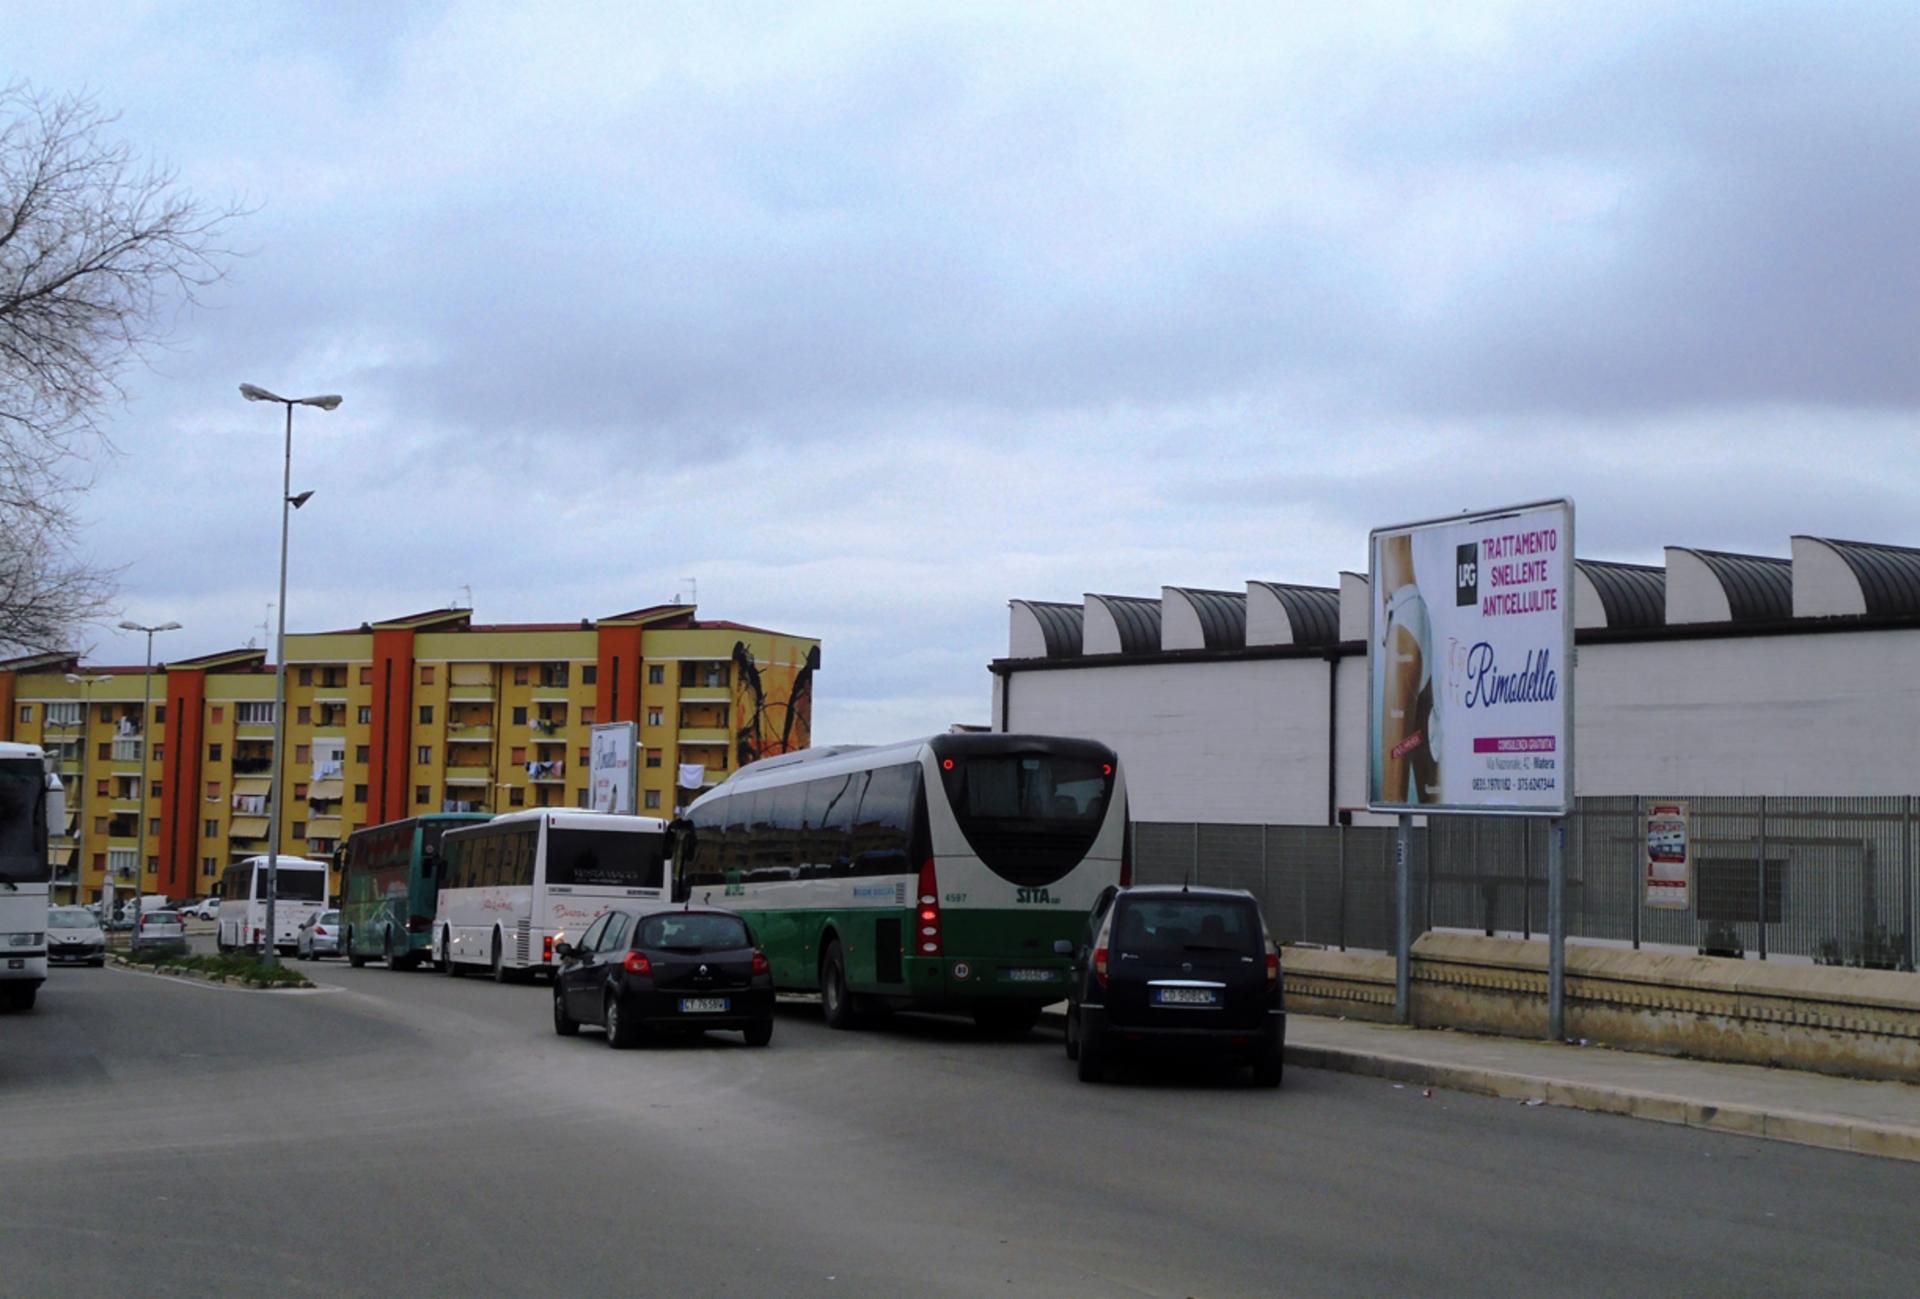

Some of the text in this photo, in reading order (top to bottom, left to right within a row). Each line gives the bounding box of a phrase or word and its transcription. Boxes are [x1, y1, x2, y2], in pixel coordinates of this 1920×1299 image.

[1482, 529, 1556, 560] TRATTAMENTO
[1491, 560, 1547, 587] SNELLENTE
[1482, 588, 1557, 617] ANTICELLULITE
[1465, 641, 1557, 708] Rimodella
[1016, 888, 1050, 904] SITA
